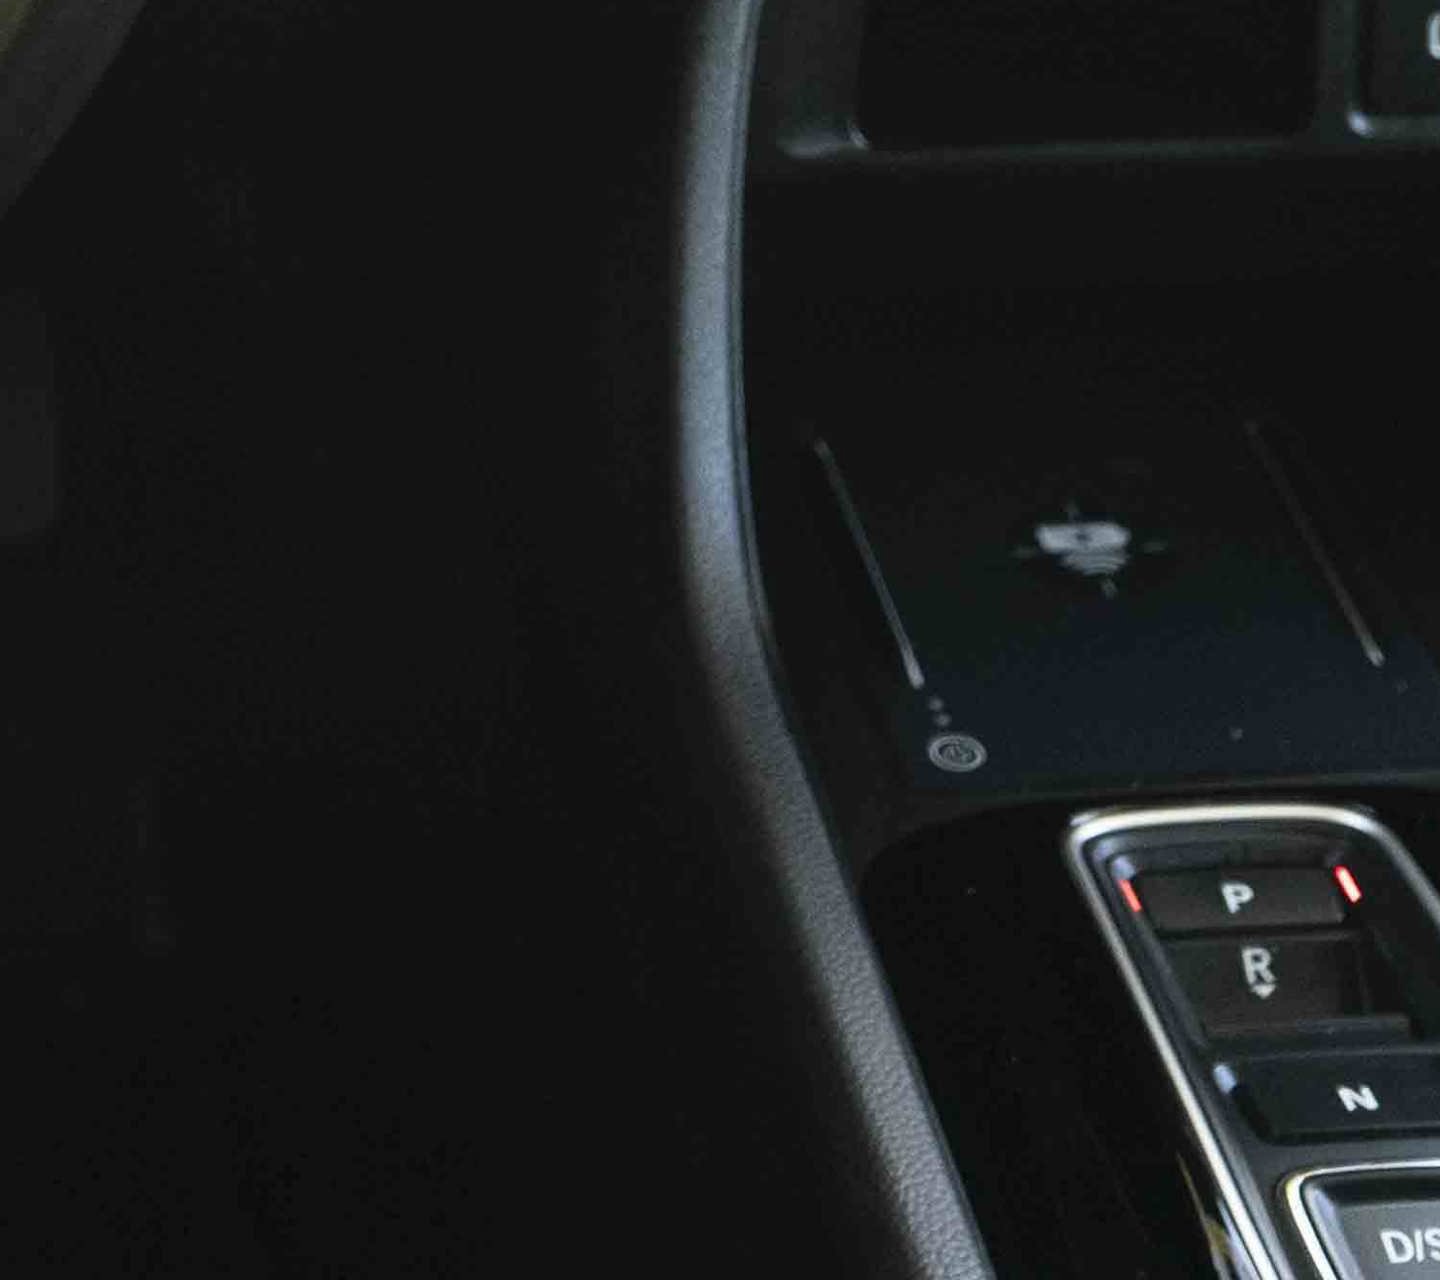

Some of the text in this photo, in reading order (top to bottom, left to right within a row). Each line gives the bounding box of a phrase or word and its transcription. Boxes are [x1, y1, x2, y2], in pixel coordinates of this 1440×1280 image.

[1220, 882, 1255, 915] P
[1241, 947, 1277, 984] R
[1336, 1084, 1381, 1112] N
